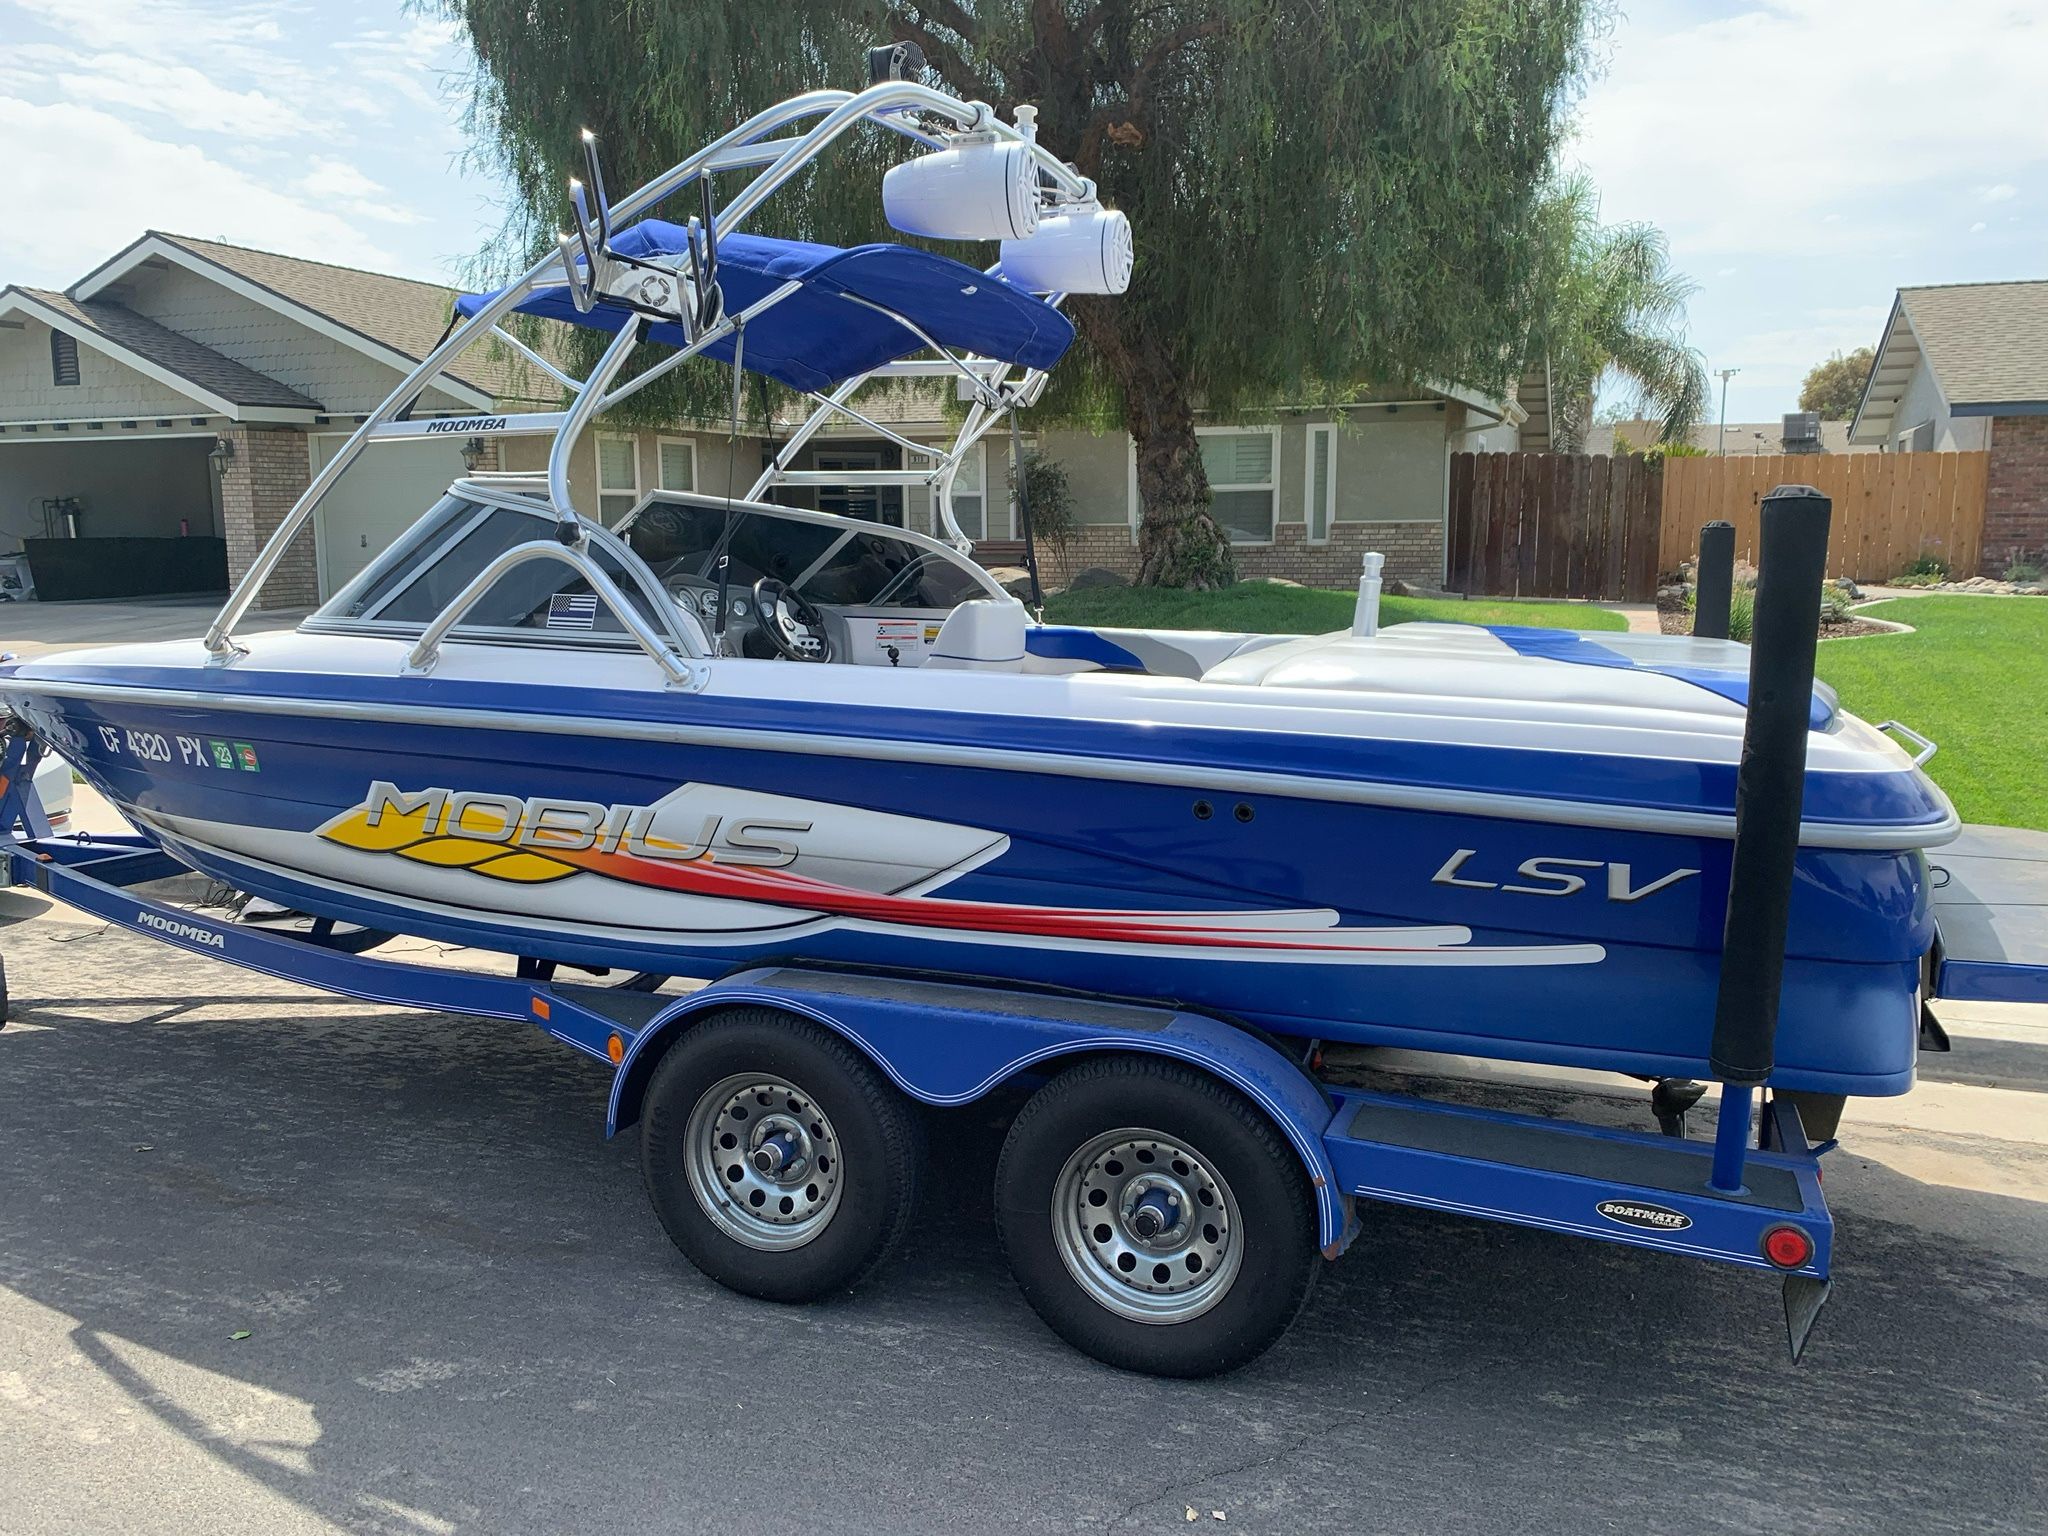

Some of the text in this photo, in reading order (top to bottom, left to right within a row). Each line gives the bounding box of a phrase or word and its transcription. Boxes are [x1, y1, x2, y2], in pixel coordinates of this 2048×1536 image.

[426, 418, 507, 433] MOOMBA
[97, 725, 121, 754] CF
[125, 730, 172, 763] 4320
[175, 735, 210, 768] PX
[217, 746, 233, 763] 23
[366, 781, 813, 868] MOBIUS
[1431, 849, 1702, 901] LSV
[137, 911, 225, 949] MOOMBA
[1603, 1204, 1685, 1225] BOATMATE
